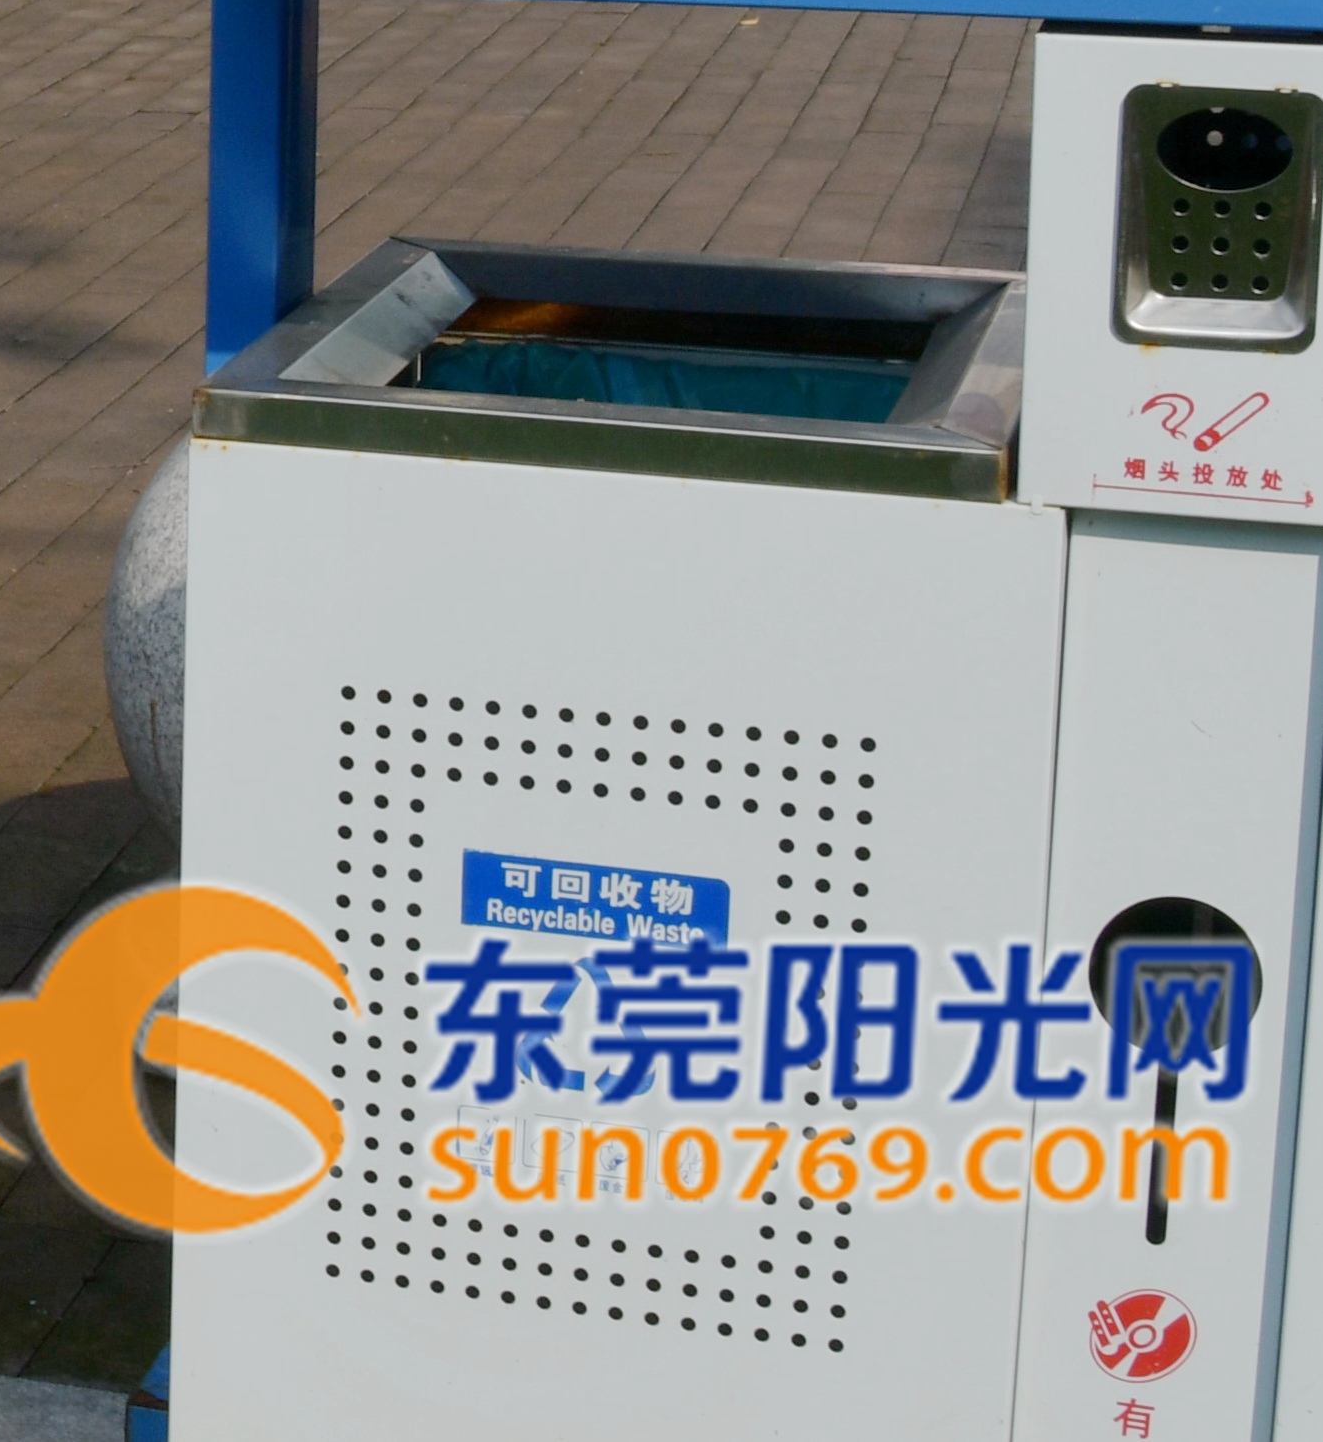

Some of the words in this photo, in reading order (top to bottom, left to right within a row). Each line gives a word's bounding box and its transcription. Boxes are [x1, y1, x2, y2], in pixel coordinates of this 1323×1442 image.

[1124, 457, 1283, 491] 烟头投放处
[500, 860, 694, 916] 可回收物
[485, 897, 616, 935] Recyclable
[626, 912, 705, 945] Waste
[1113, 1397, 1156, 1439] 有
